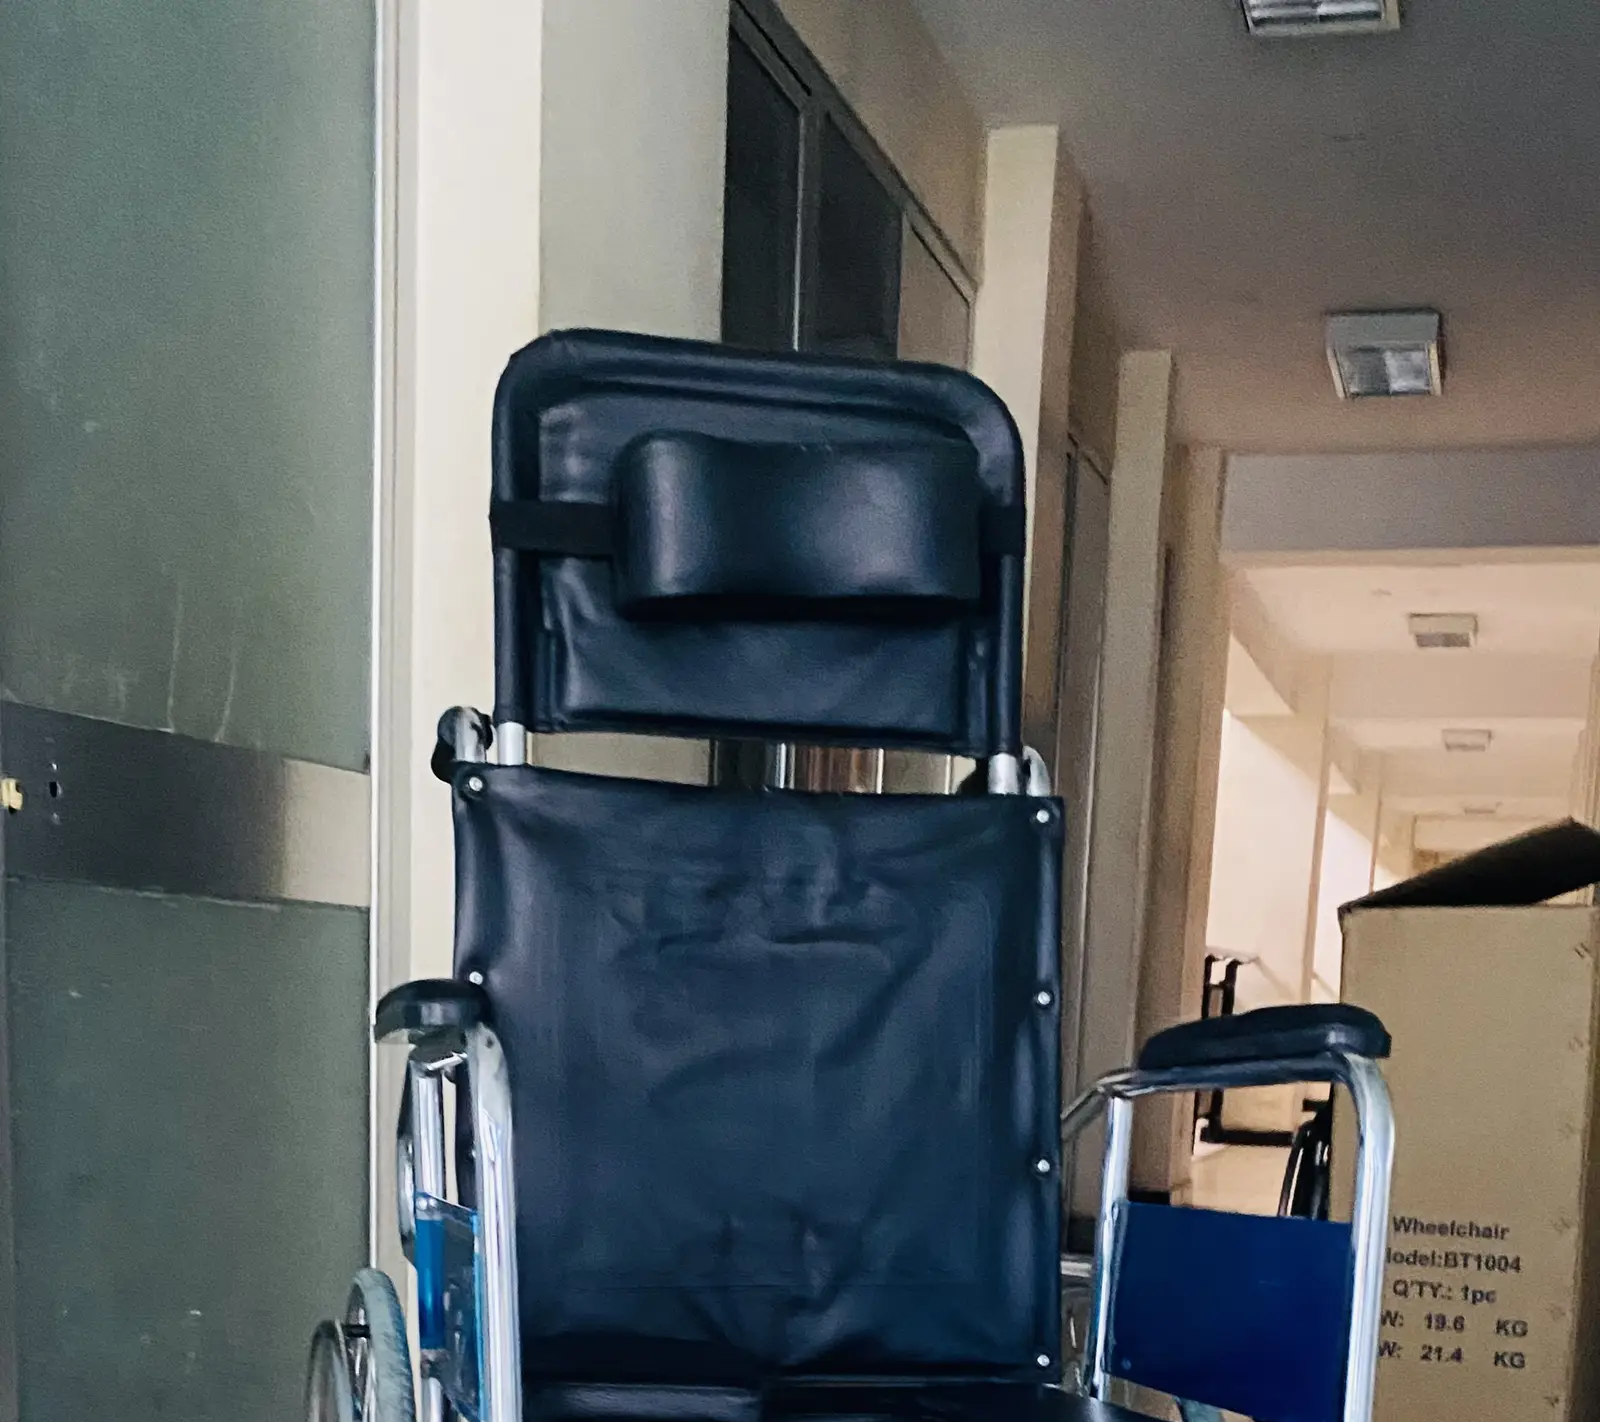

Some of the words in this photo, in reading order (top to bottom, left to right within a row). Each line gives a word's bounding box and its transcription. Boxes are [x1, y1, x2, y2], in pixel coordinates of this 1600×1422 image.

[1393, 1215, 1510, 1241] Wheelchair
[1386, 1246, 1521, 1274] odel:BT1004
[1461, 1284, 1498, 1305] 1pc
[1424, 1312, 1466, 1334] 19.6
[1495, 1317, 1529, 1338] KG
[1420, 1344, 1463, 1365] 21.4
[1493, 1350, 1527, 1370] KG
